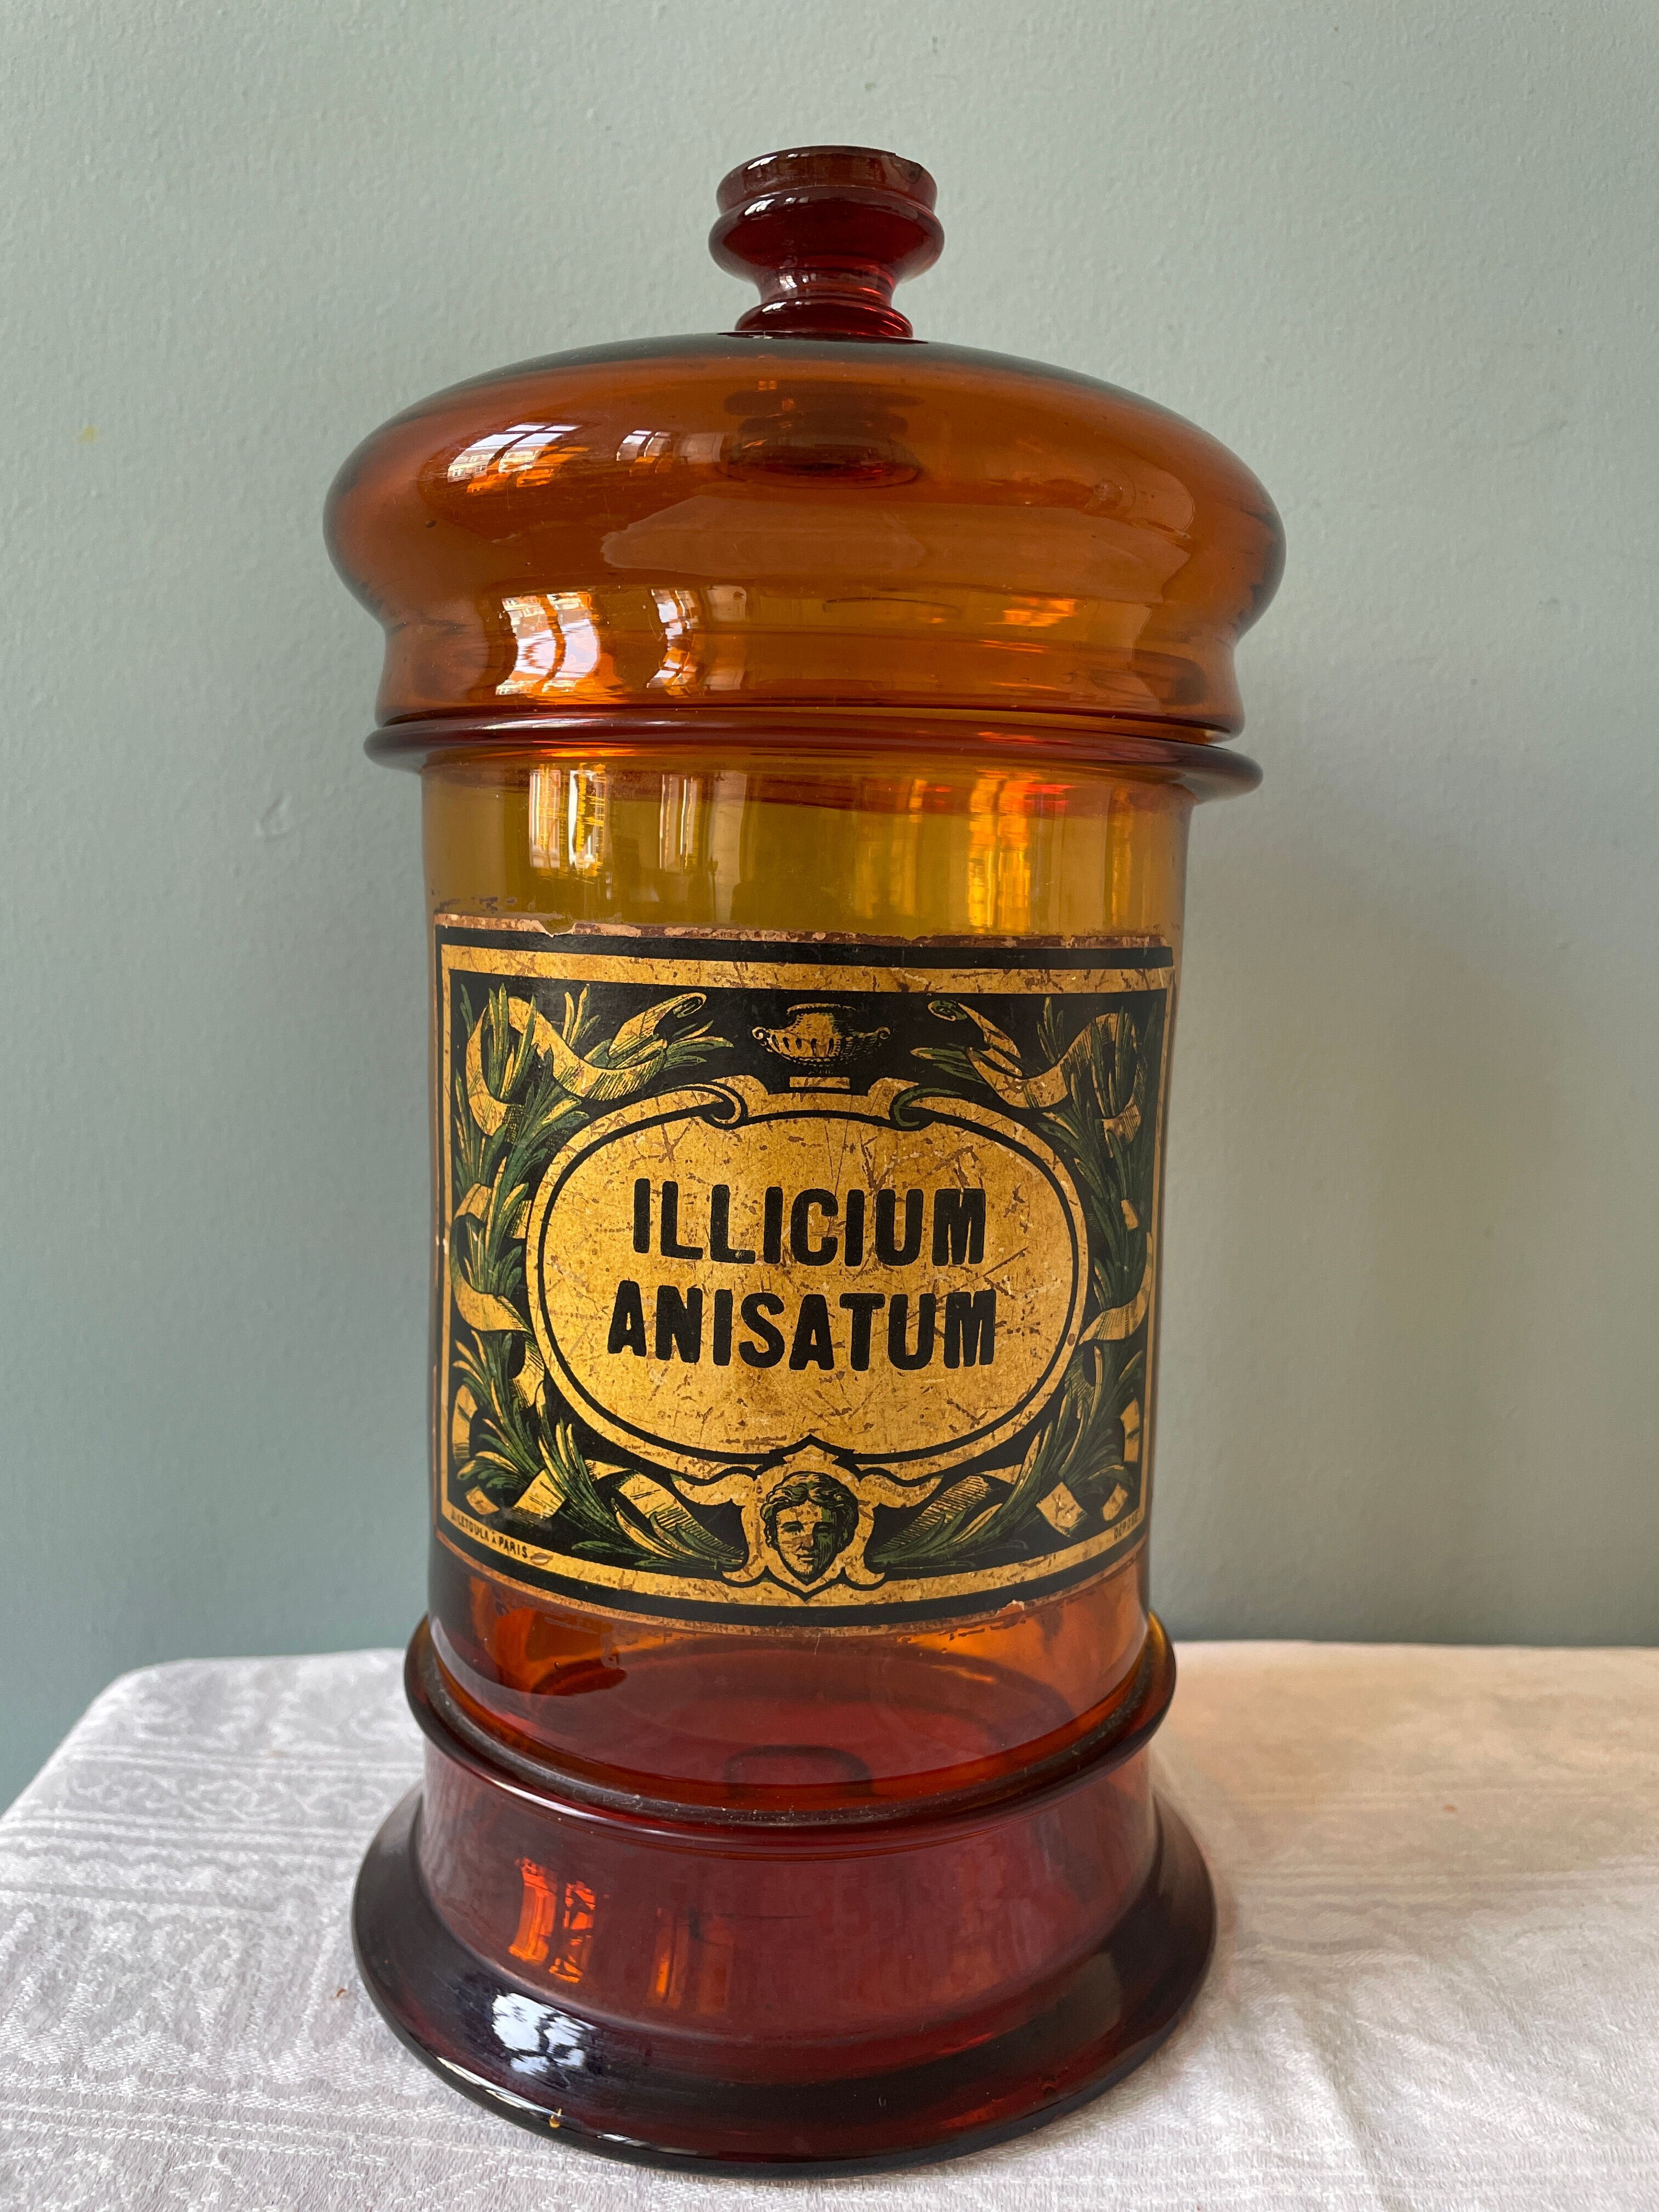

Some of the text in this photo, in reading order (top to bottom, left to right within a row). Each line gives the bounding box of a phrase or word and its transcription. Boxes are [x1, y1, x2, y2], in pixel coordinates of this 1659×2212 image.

[634, 1178, 986, 1267] ILLICIUM
[607, 1279, 997, 1372] ANISATUM
[499, 1536, 528, 1559] PARIS
